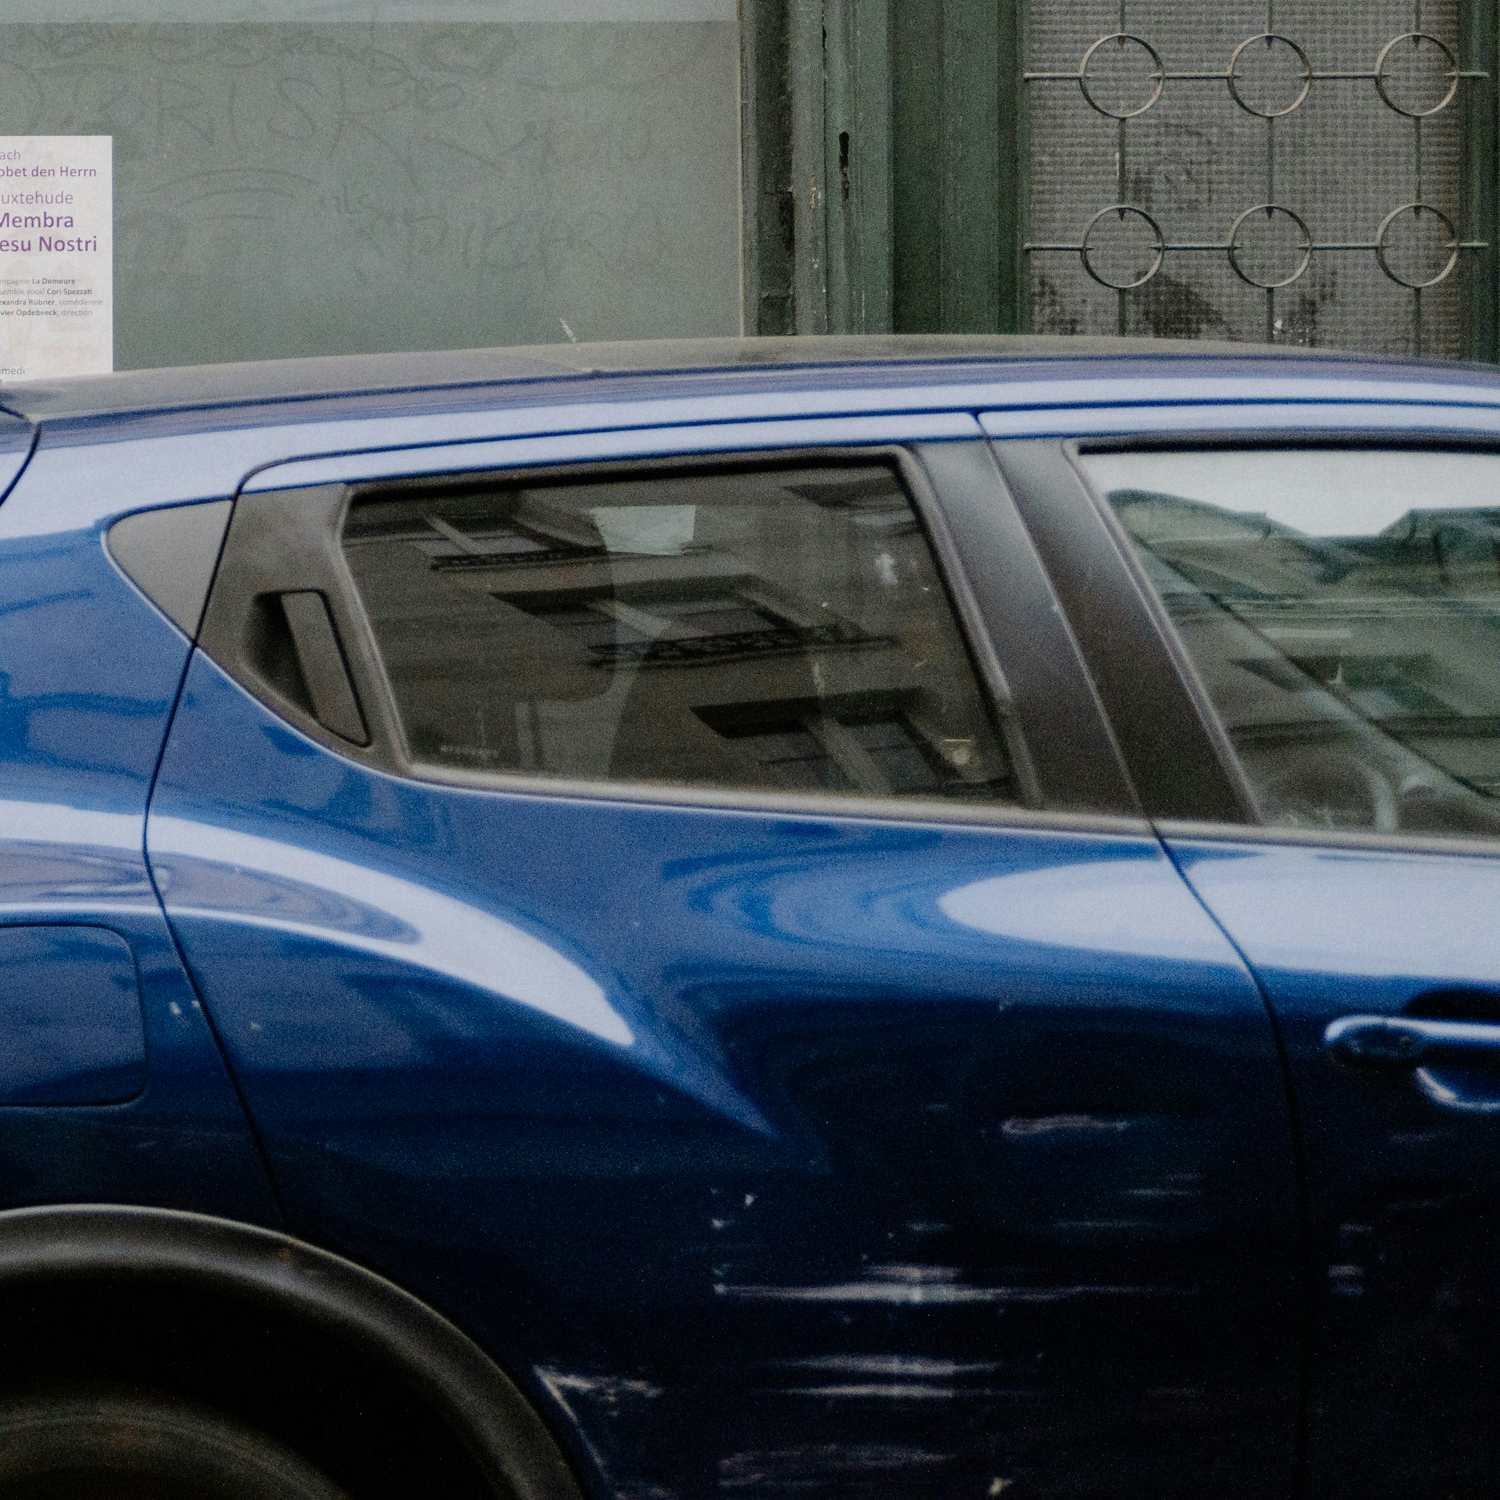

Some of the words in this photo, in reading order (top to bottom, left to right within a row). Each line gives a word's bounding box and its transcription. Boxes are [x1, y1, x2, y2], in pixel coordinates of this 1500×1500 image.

[31, 166, 55, 177] den
[60, 167, 97, 177] Herrn
[39, 236, 97, 252] Nostri
